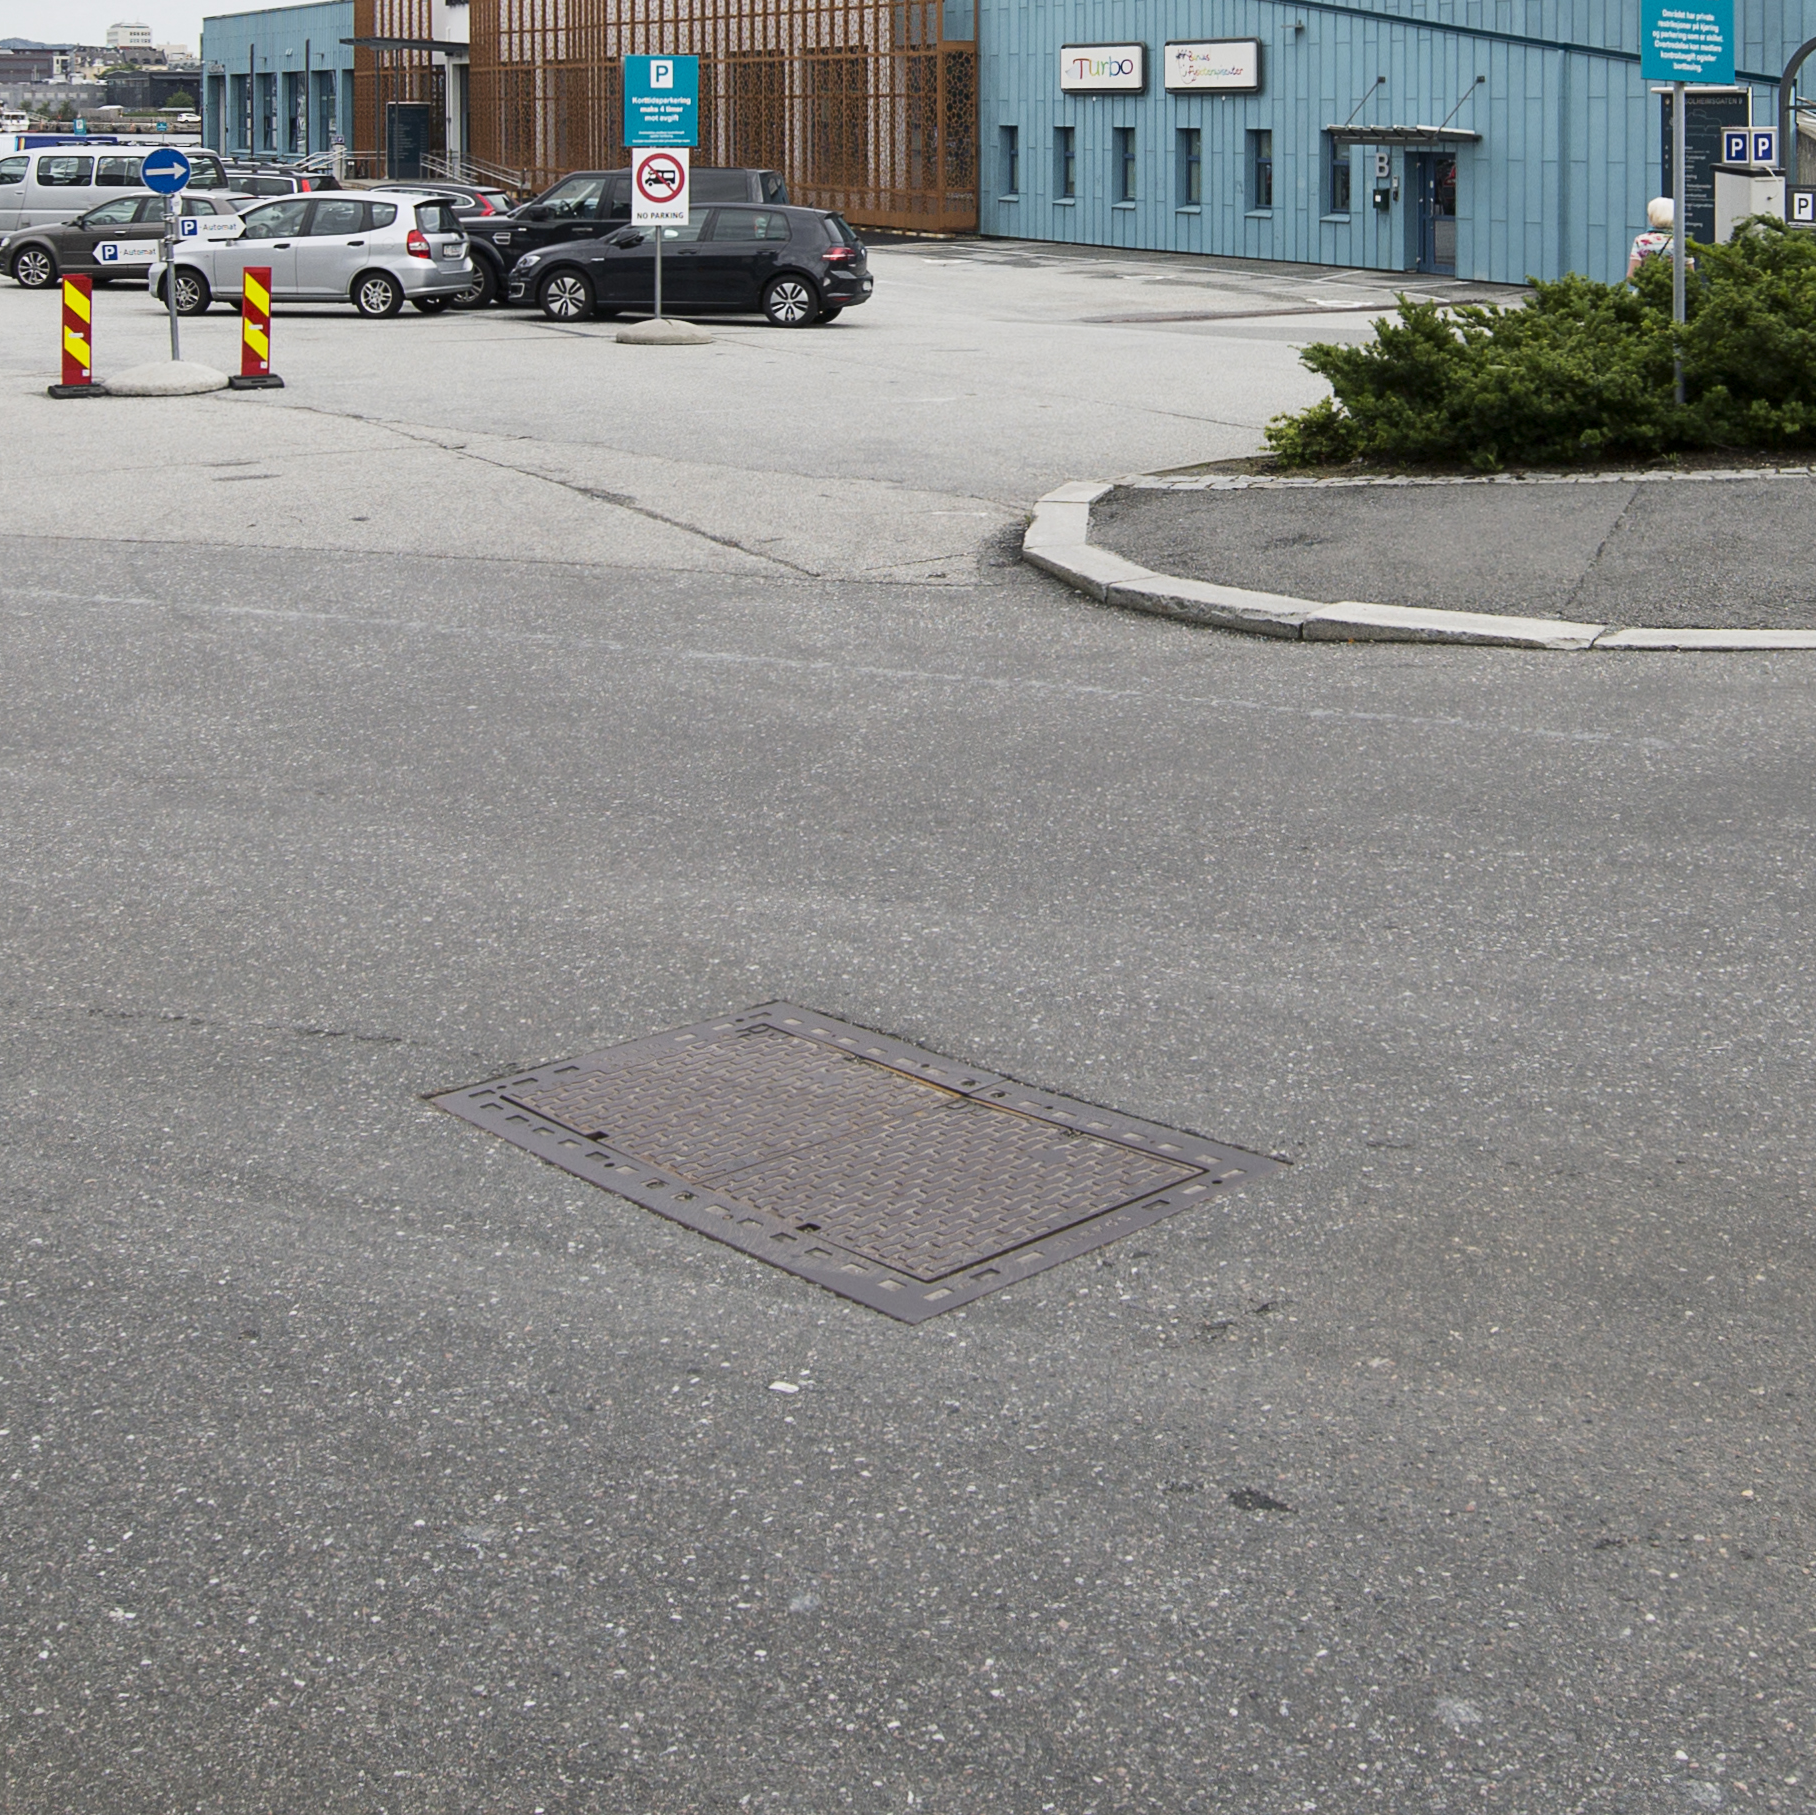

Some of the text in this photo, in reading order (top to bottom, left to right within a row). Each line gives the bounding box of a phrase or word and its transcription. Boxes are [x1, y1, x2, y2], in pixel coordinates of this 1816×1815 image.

[656, 65, 669, 83] P
[1073, 56, 1134, 79] Turbo
[632, 96, 691, 106] Korttidsparkering
[644, 114, 679, 123] mot avgift
[1731, 138, 1744, 157] P
[1758, 137, 1770, 157] P
[1376, 152, 1390, 177] B
[650, 211, 684, 219] PARKING
[1798, 197, 1810, 215] P
[187, 221, 195, 234] P
[106, 246, 115, 259] P
